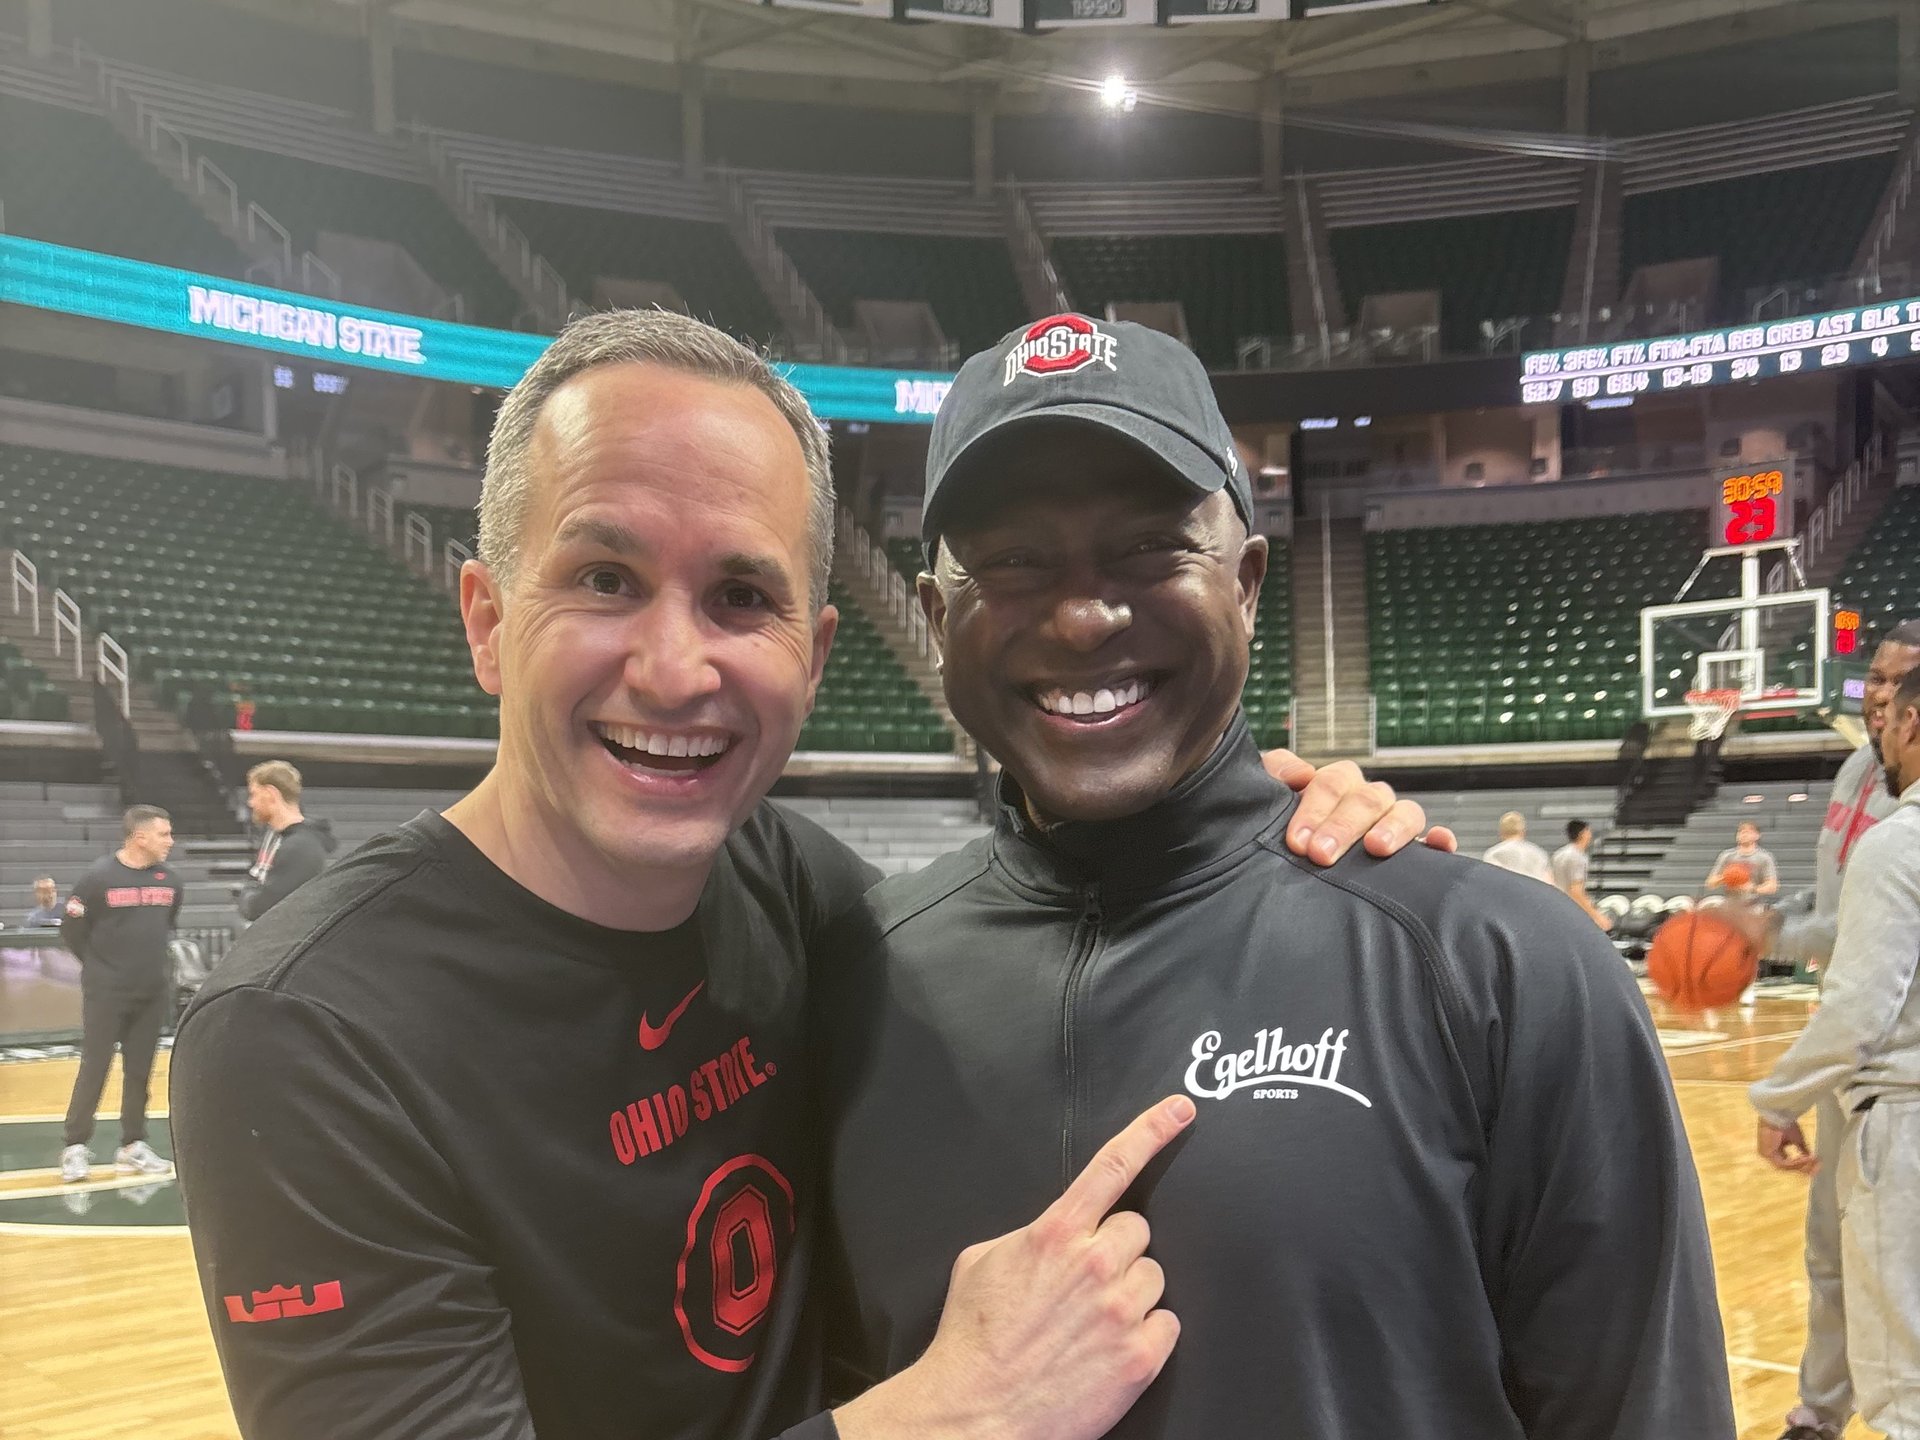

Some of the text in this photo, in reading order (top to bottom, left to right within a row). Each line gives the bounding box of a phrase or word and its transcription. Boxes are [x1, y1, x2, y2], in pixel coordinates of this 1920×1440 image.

[188, 285, 427, 365] MICHIGAN STATE
[1611, 344, 1646, 366] FT%
[1649, 333, 1726, 362] FTM-FTA
[1728, 327, 1764, 352] REB
[1767, 319, 1814, 345] OREB
[1816, 312, 1856, 338] AST
[1861, 305, 1900, 330] BLK
[1722, 470, 1784, 505] 30:59
[1725, 497, 1777, 545] 23
[1184, 1026, 1350, 1101] Egelhoff
[1252, 1088, 1299, 1100] SPORTS
[609, 1083, 690, 1166] OHIO
